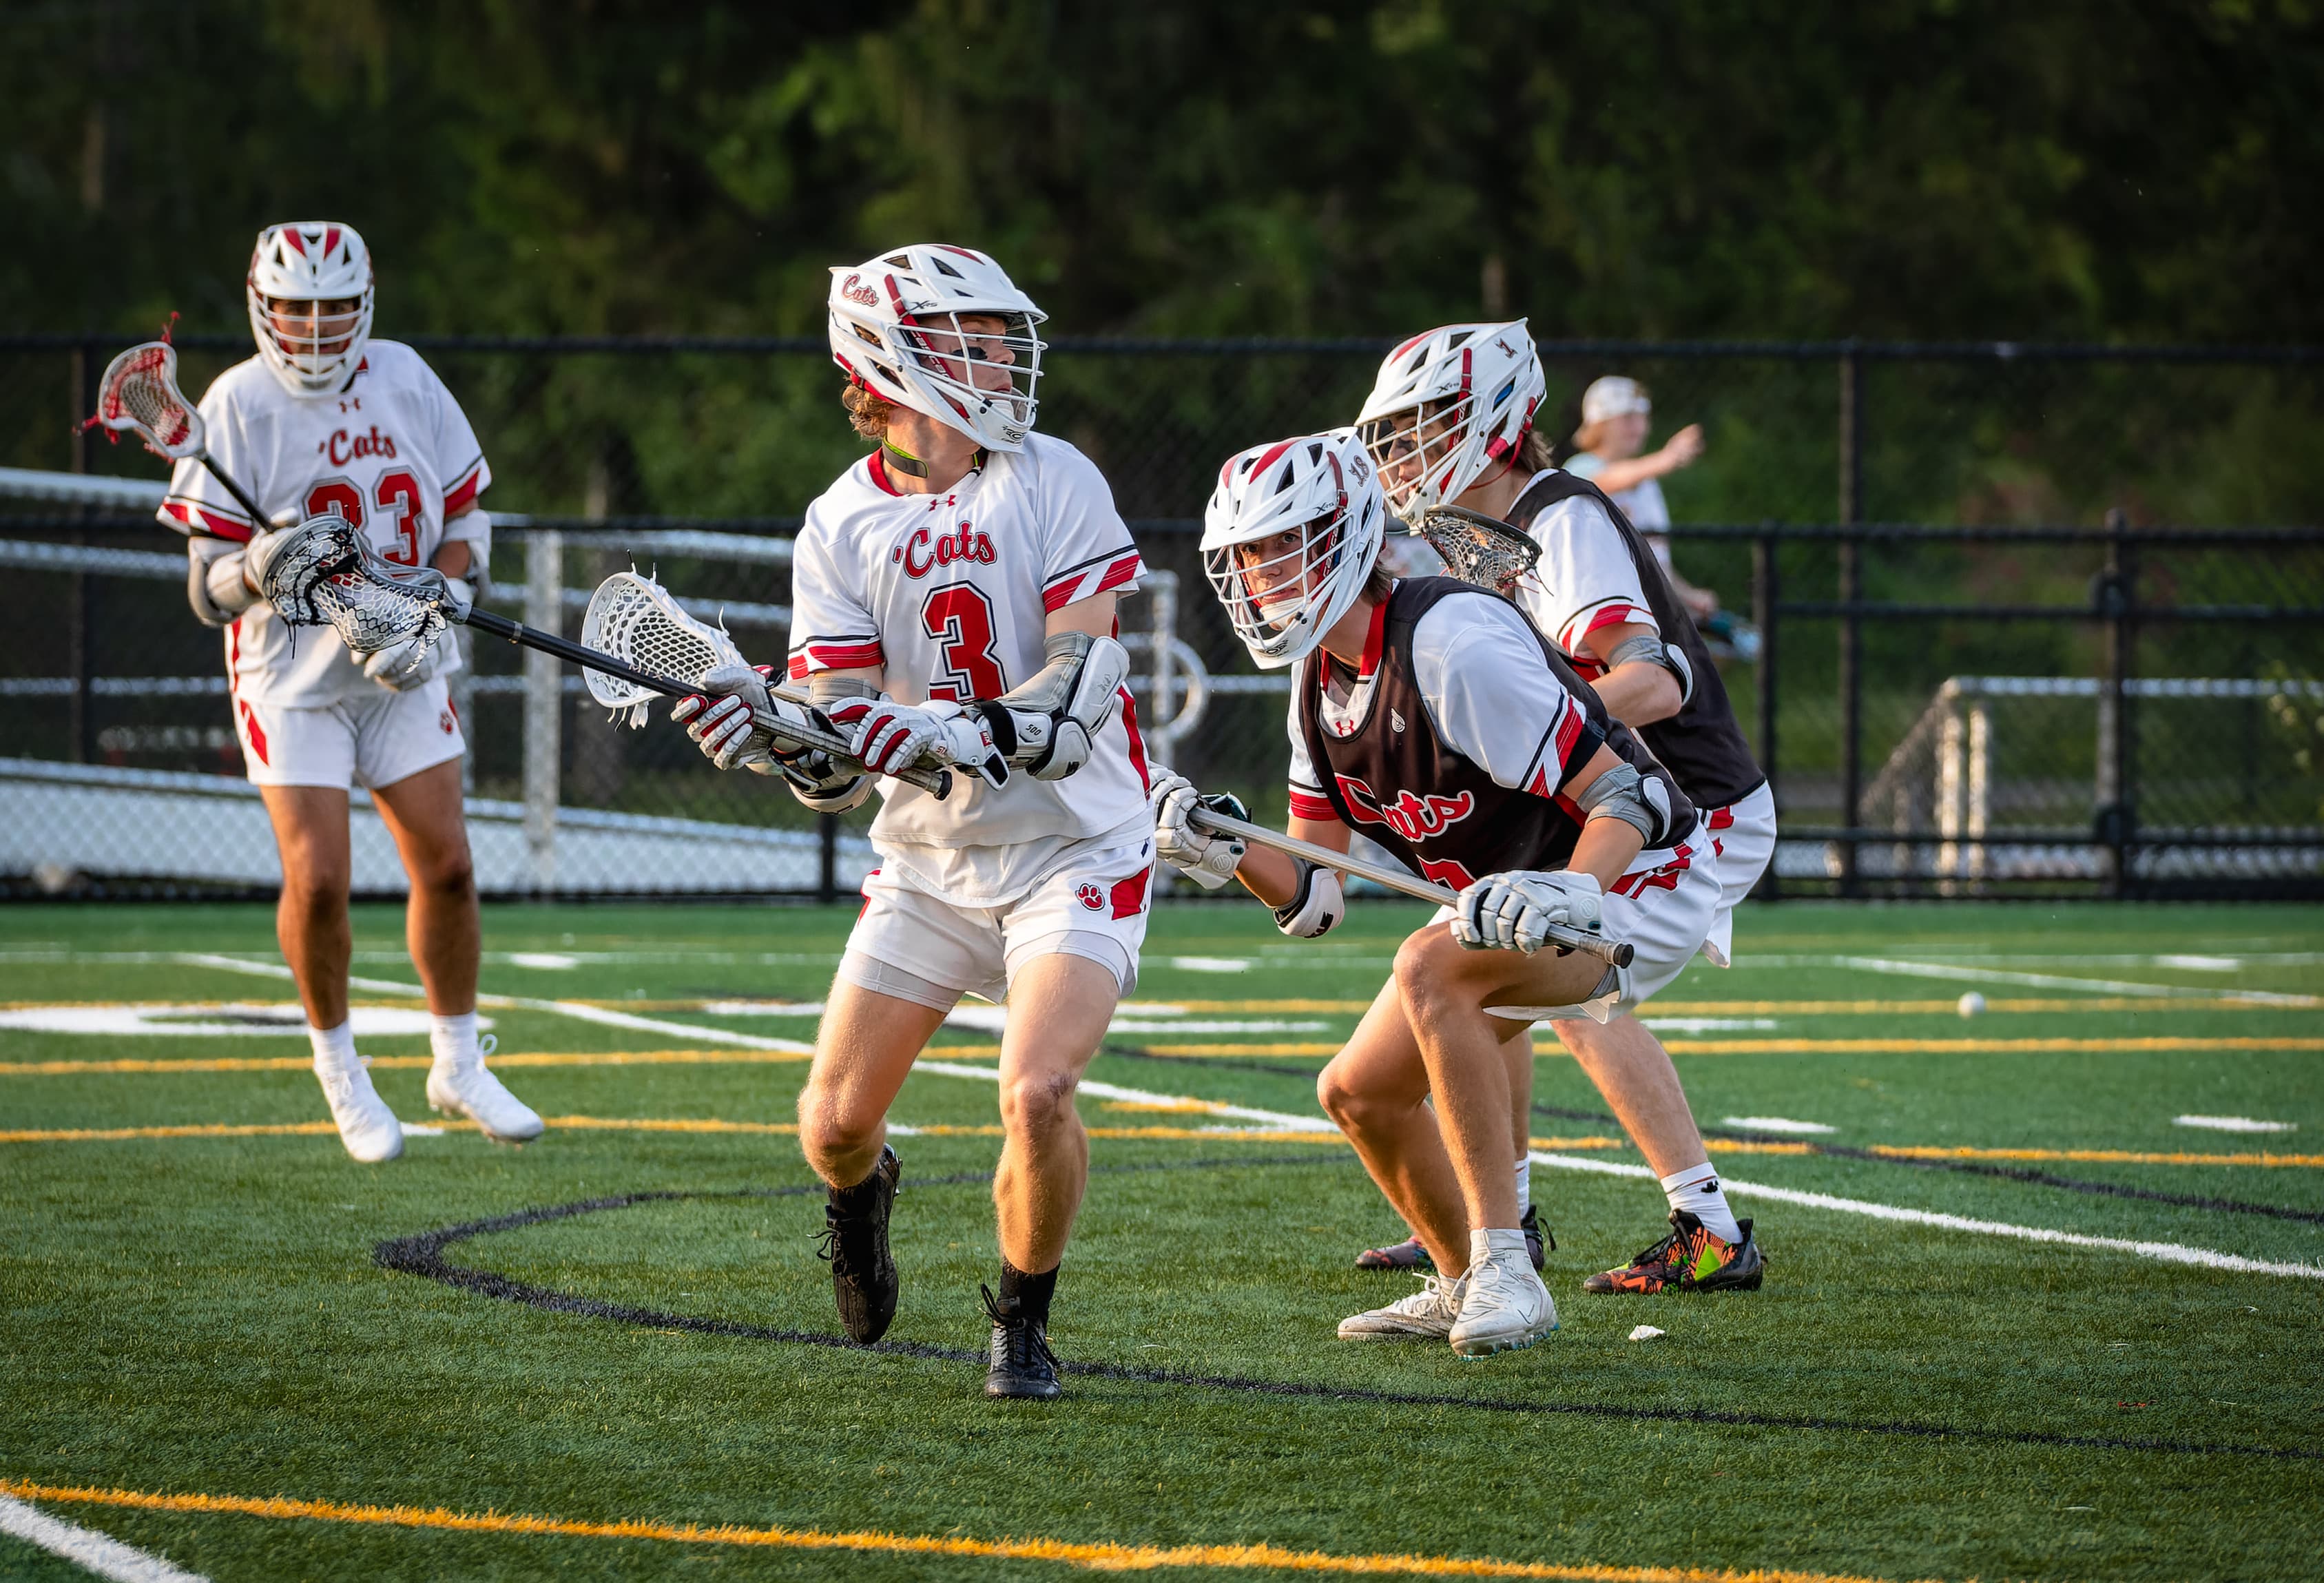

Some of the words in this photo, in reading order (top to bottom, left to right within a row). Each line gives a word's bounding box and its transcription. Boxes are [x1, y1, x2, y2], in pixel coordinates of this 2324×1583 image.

[1495, 338, 1518, 359] 1
[892, 520, 998, 579] 'Cats
[920, 579, 1010, 702] 3
[1025, 723, 1042, 736] 500
